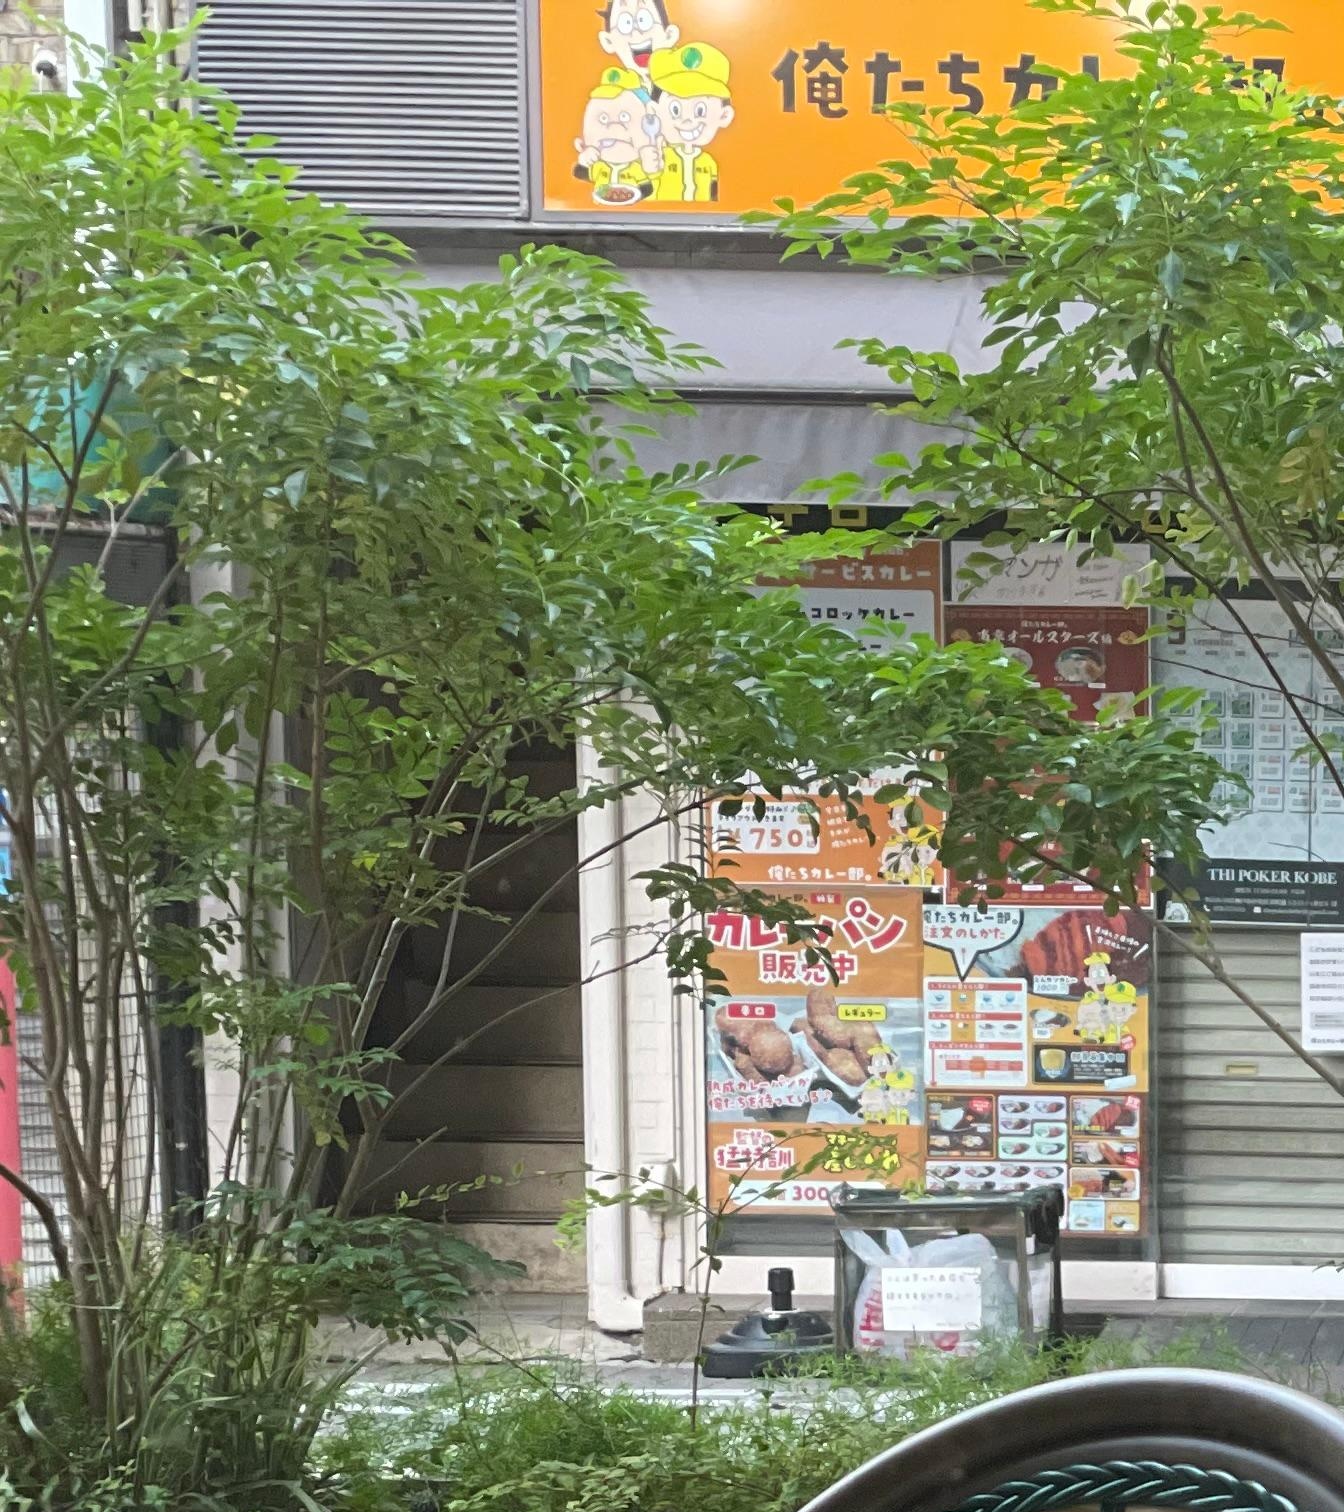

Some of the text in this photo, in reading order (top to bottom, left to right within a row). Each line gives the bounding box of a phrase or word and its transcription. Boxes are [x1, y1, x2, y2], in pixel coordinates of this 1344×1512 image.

[768, 865, 873, 881] 俺たちカレー部。
[1238, 869, 1291, 883] POKER
[1294, 871, 1338, 885] KOBE
